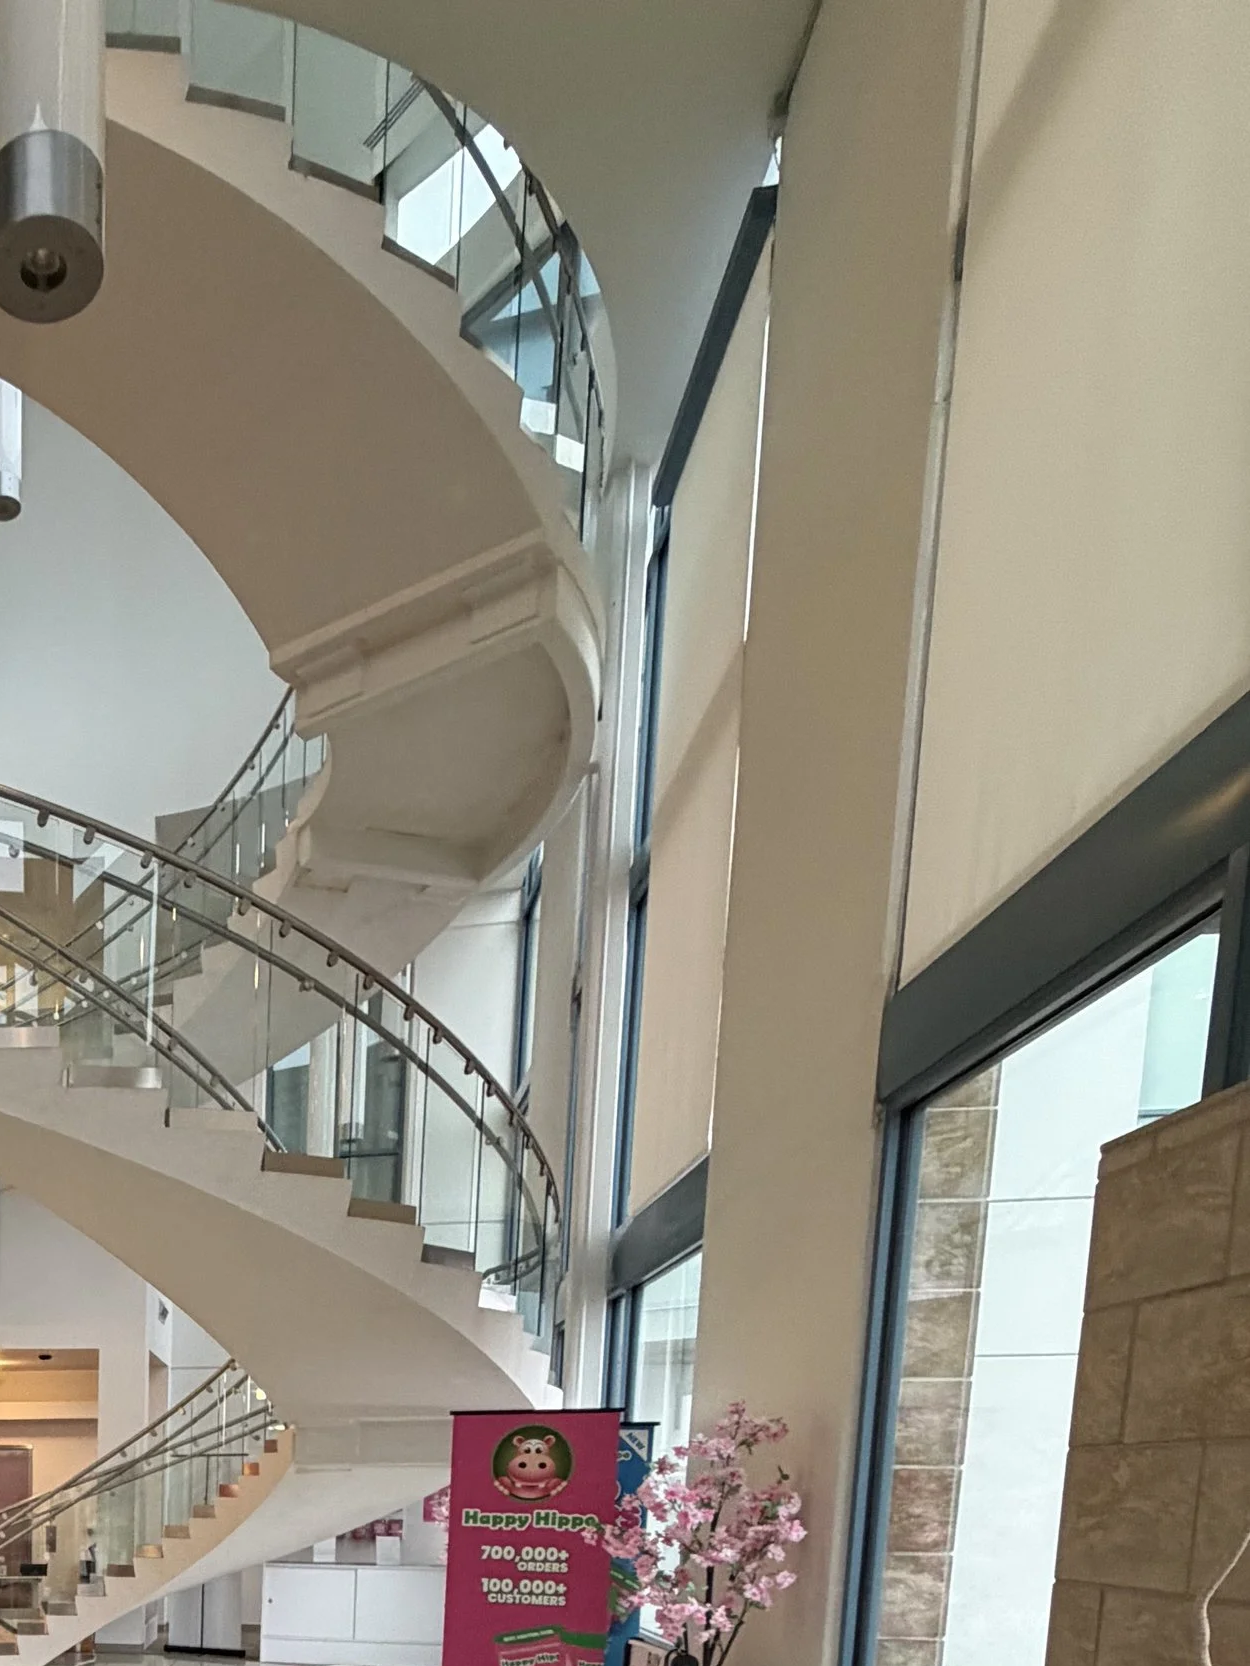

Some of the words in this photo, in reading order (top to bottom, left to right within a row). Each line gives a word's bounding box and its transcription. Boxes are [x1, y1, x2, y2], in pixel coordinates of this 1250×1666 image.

[462, 1508, 531, 1531] Happy
[481, 1545, 569, 1563] 700,000+
[517, 1561, 568, 1573] ORDERS
[481, 1577, 567, 1596] 100,000+
[488, 1593, 567, 1606] CUSTOMERS
